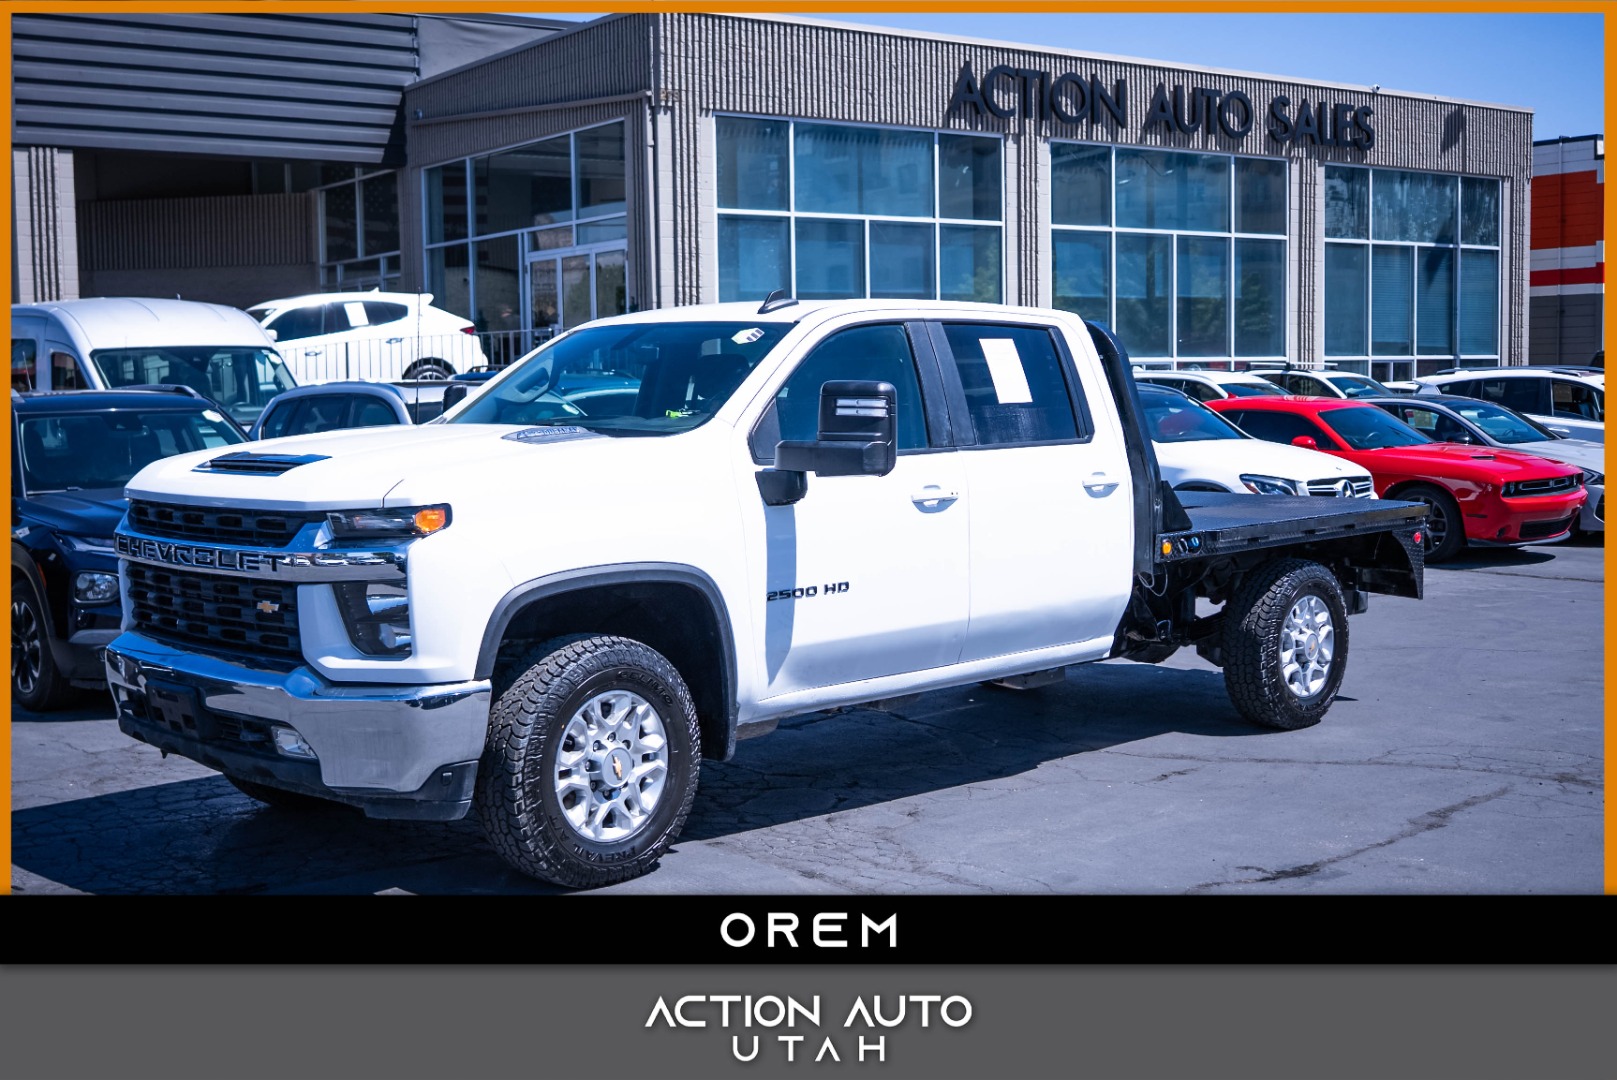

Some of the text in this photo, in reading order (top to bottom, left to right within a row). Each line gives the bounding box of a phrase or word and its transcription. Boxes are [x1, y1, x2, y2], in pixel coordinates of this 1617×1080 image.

[949, 61, 1375, 151] ACTION AUTO SALES
[116, 535, 286, 572] CHEVROLET
[766, 581, 850, 602] 2500 HD
